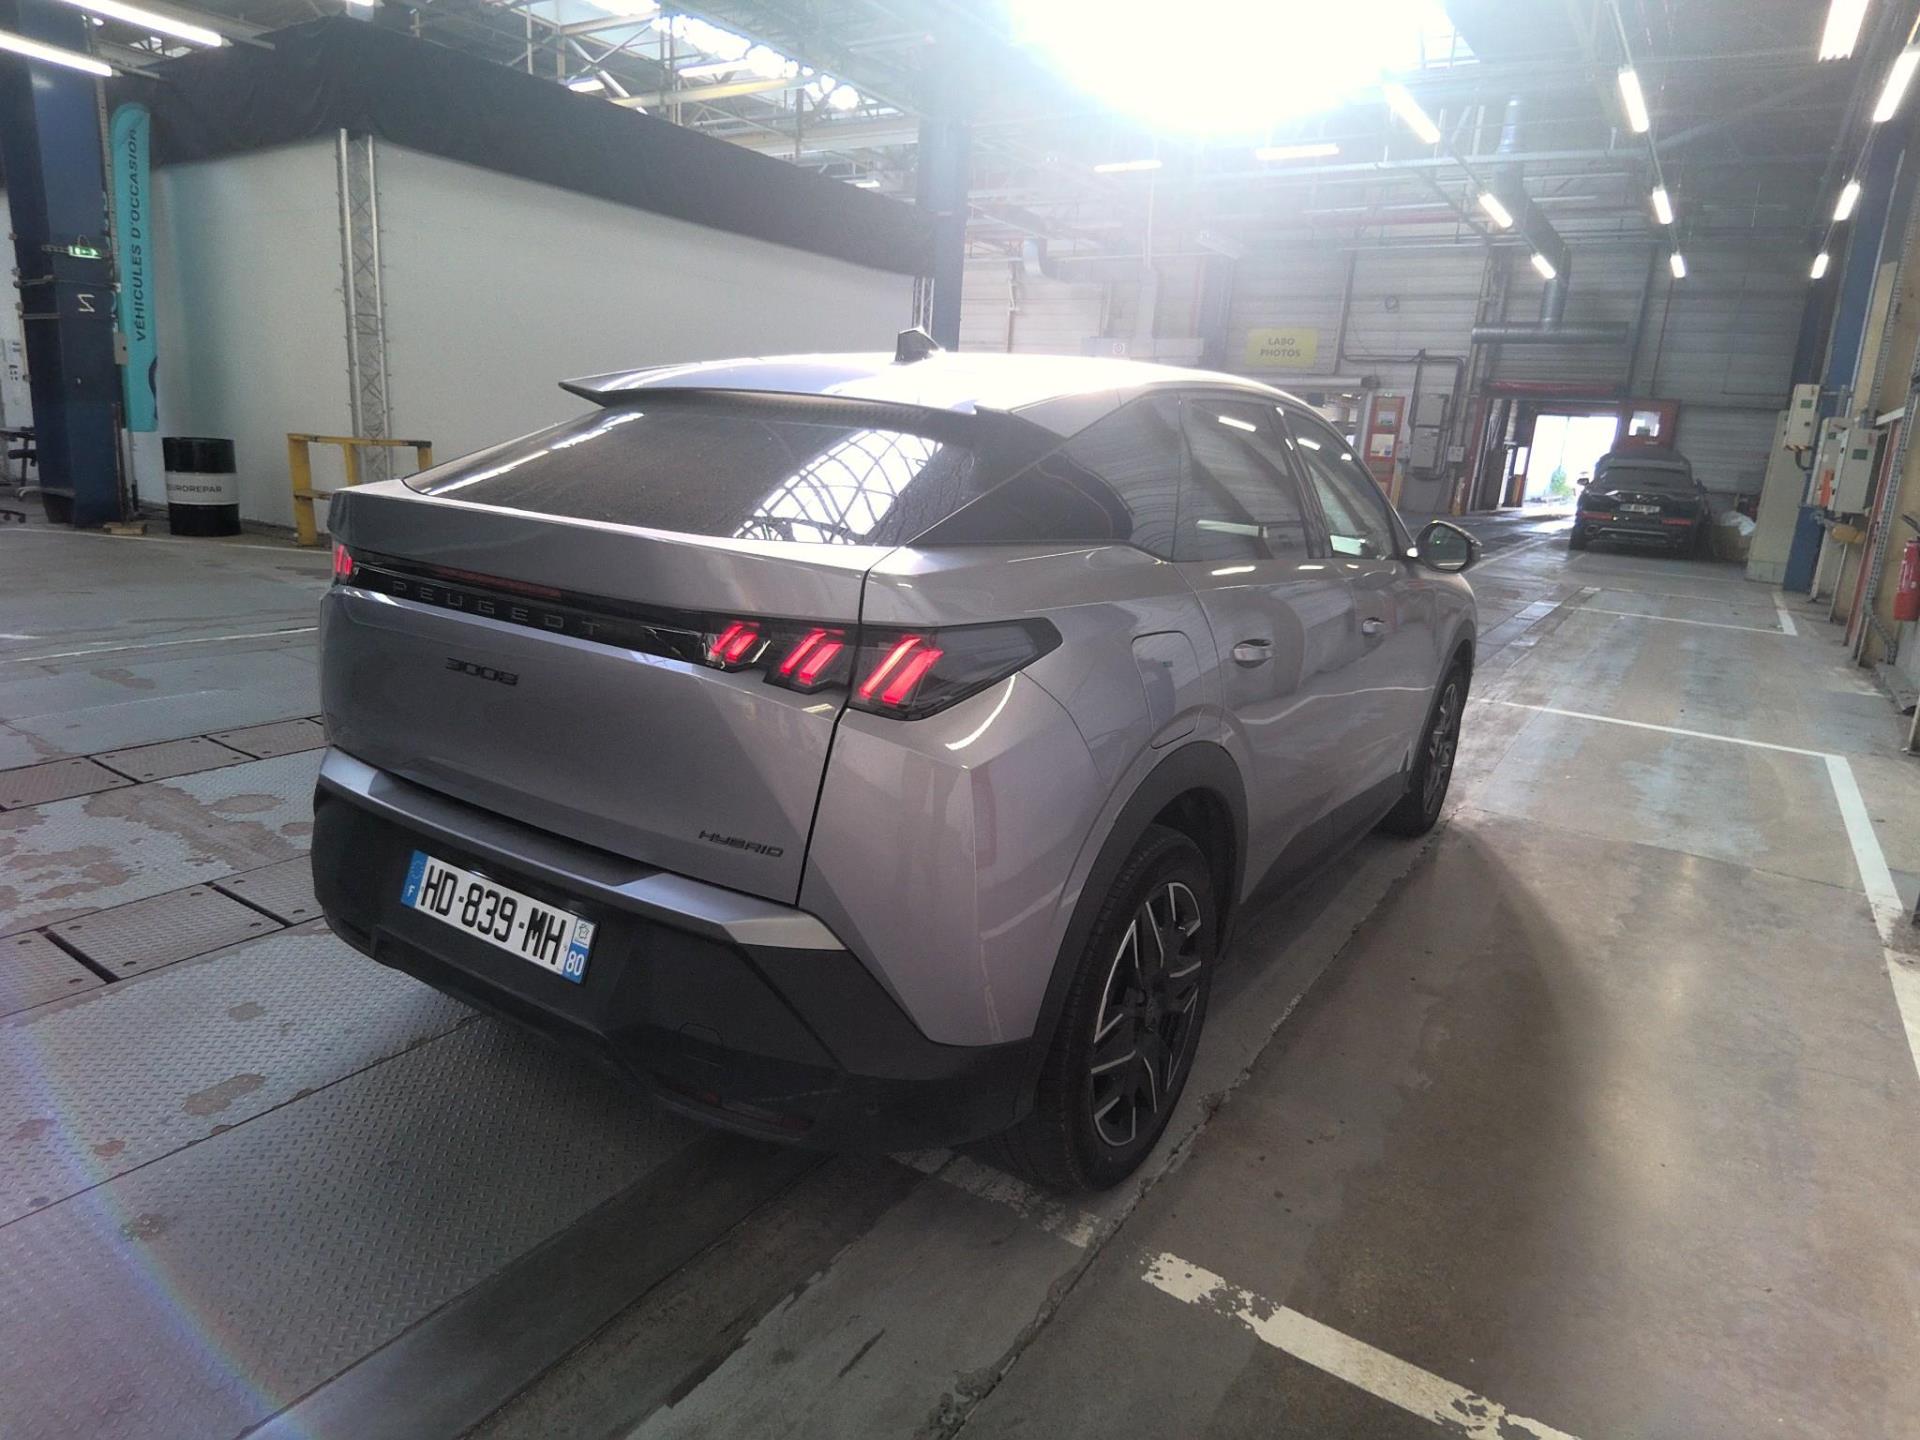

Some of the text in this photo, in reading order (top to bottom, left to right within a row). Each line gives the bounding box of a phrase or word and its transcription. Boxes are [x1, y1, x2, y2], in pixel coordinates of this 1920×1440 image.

[134, 244, 146, 342] VÉHICULES
[1260, 348, 1301, 357] PHOTOS
[1268, 337, 1295, 346] LABO
[392, 580, 600, 636] PEUGEOT
[445, 657, 520, 686] 3008
[698, 830, 784, 857] HYBRID
[407, 864, 567, 966] F HD-839-MH
[565, 949, 585, 976] 80
